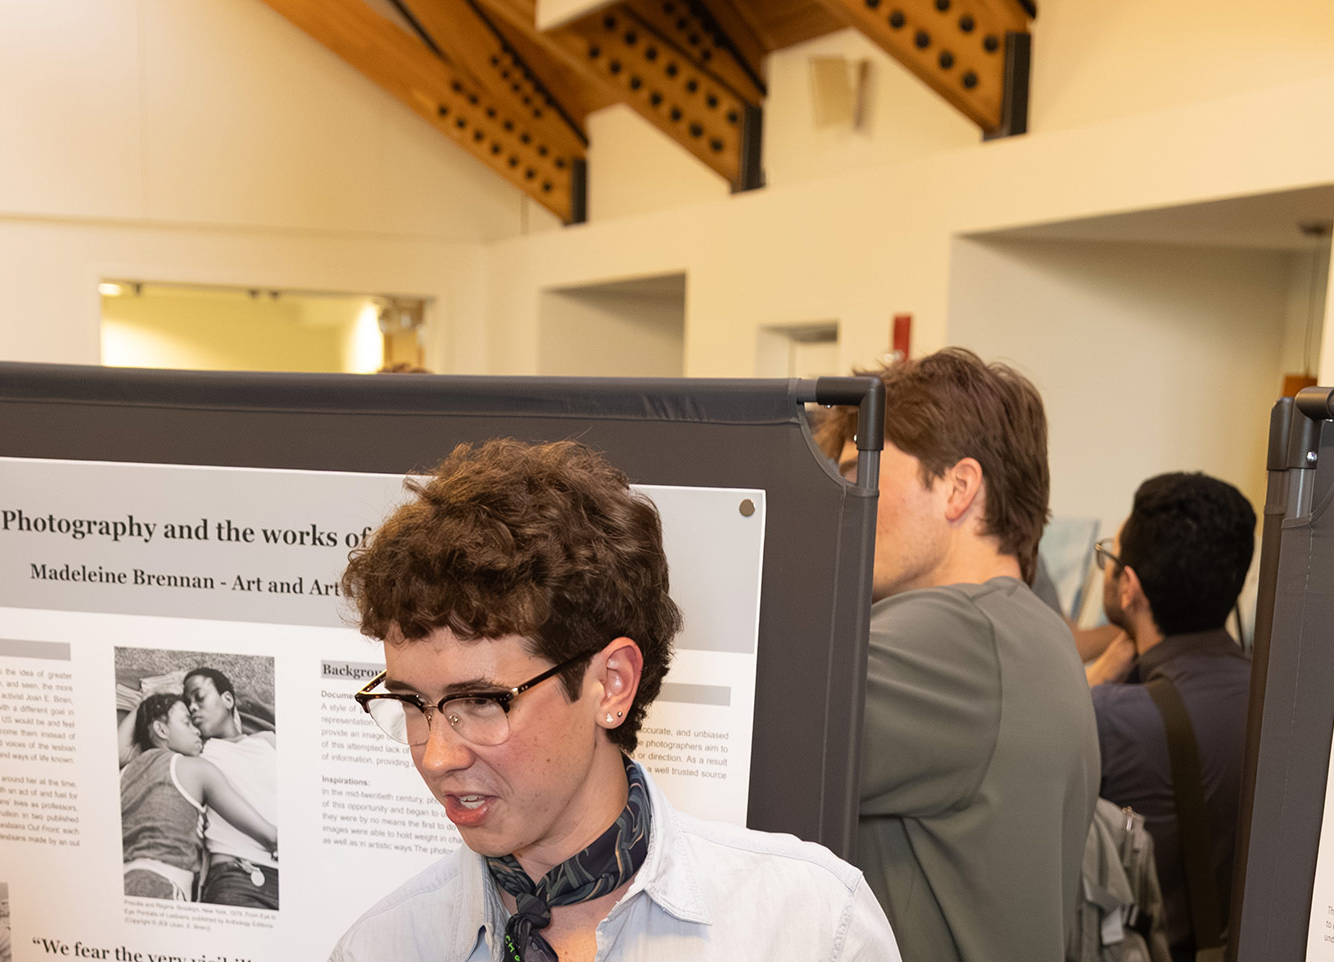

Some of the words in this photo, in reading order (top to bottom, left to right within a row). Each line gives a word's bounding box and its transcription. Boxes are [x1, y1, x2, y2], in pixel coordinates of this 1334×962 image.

[1, 510, 157, 542] Photography
[164, 519, 209, 540] and
[216, 520, 255, 543] the
[262, 524, 338, 547] works
[345, 527, 372, 548] of
[30, 564, 127, 584] Madeleine
[132, 569, 215, 589] Brennan
[232, 575, 263, 592] Art
[268, 577, 303, 595] and
[309, 579, 340, 596] Art
[323, 664, 382, 679] Backgrou
[646, 740, 702, 752] photographers
[32, 937, 69, 956] “We
[74, 942, 109, 960] fear
